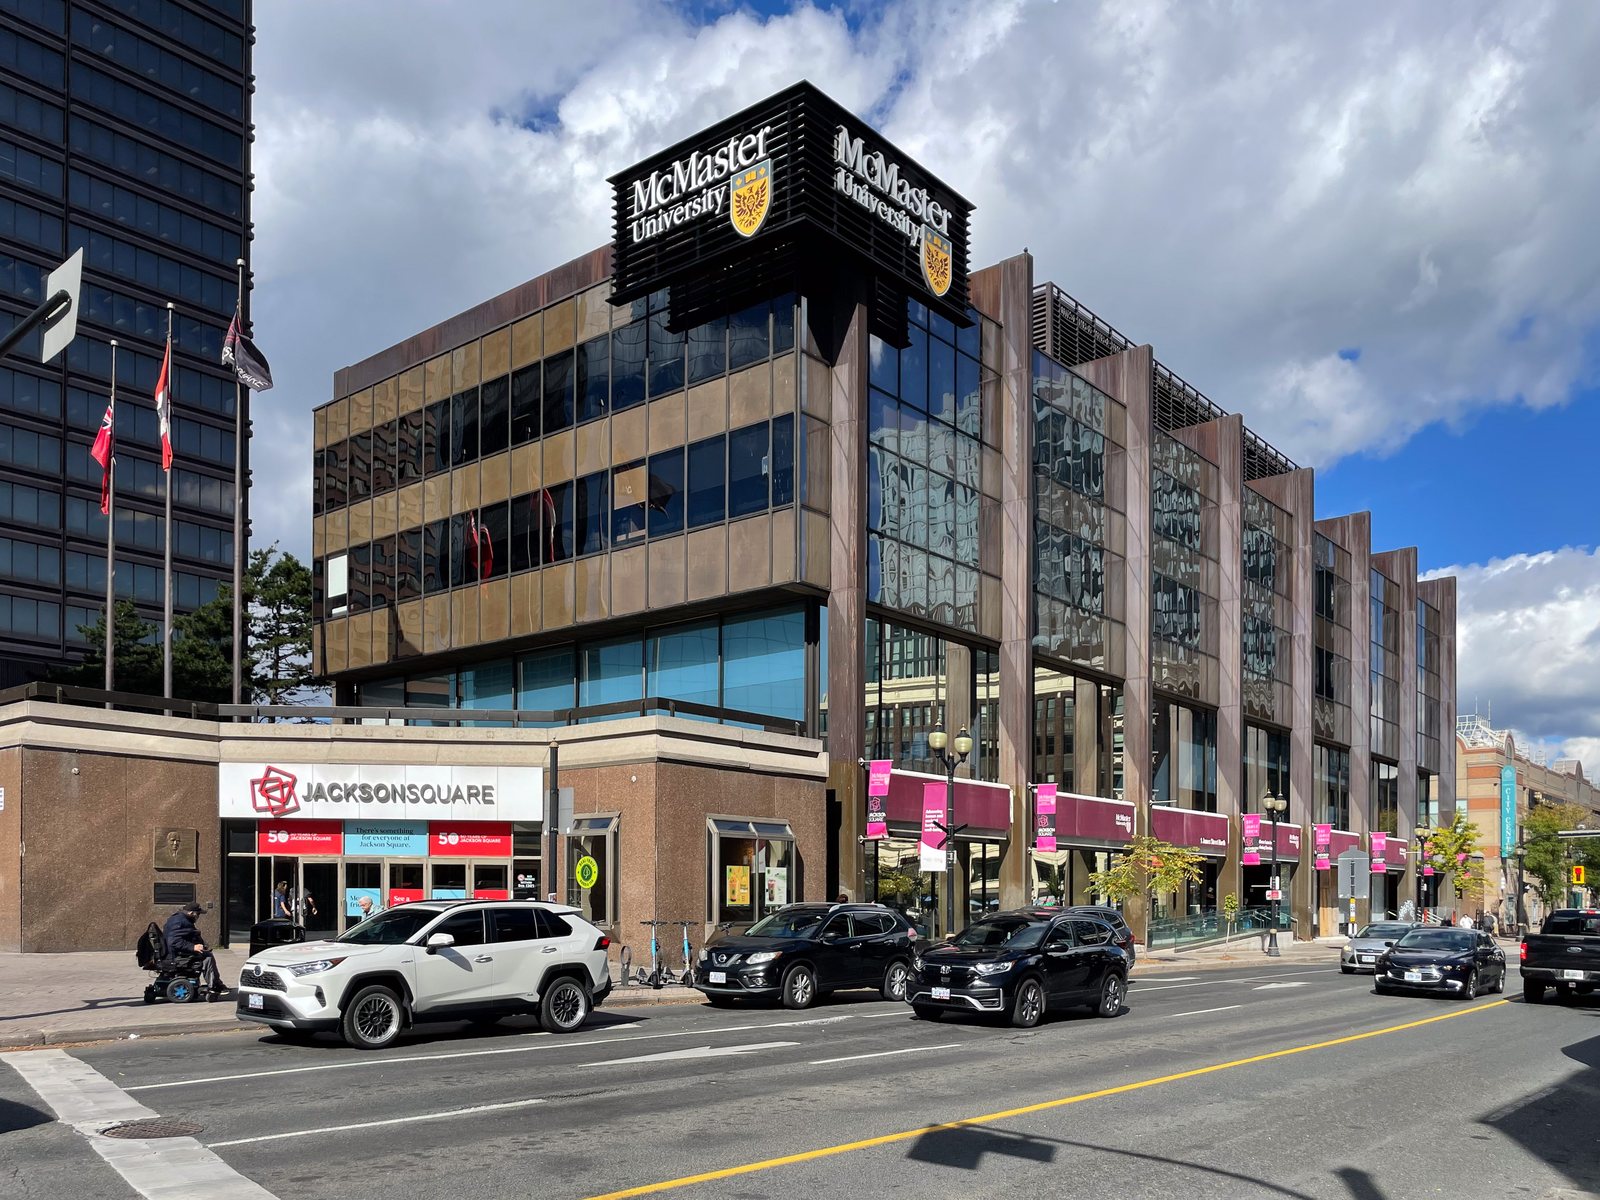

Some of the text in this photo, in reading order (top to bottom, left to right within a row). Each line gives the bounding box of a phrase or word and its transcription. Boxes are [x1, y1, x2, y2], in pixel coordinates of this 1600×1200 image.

[631, 125, 772, 218] McMaster
[835, 124, 953, 237] McMaster
[632, 185, 727, 244] University
[835, 166, 923, 248] University
[301, 782, 496, 804] JACKSONSQUARE
[380, 827, 414, 835] something
